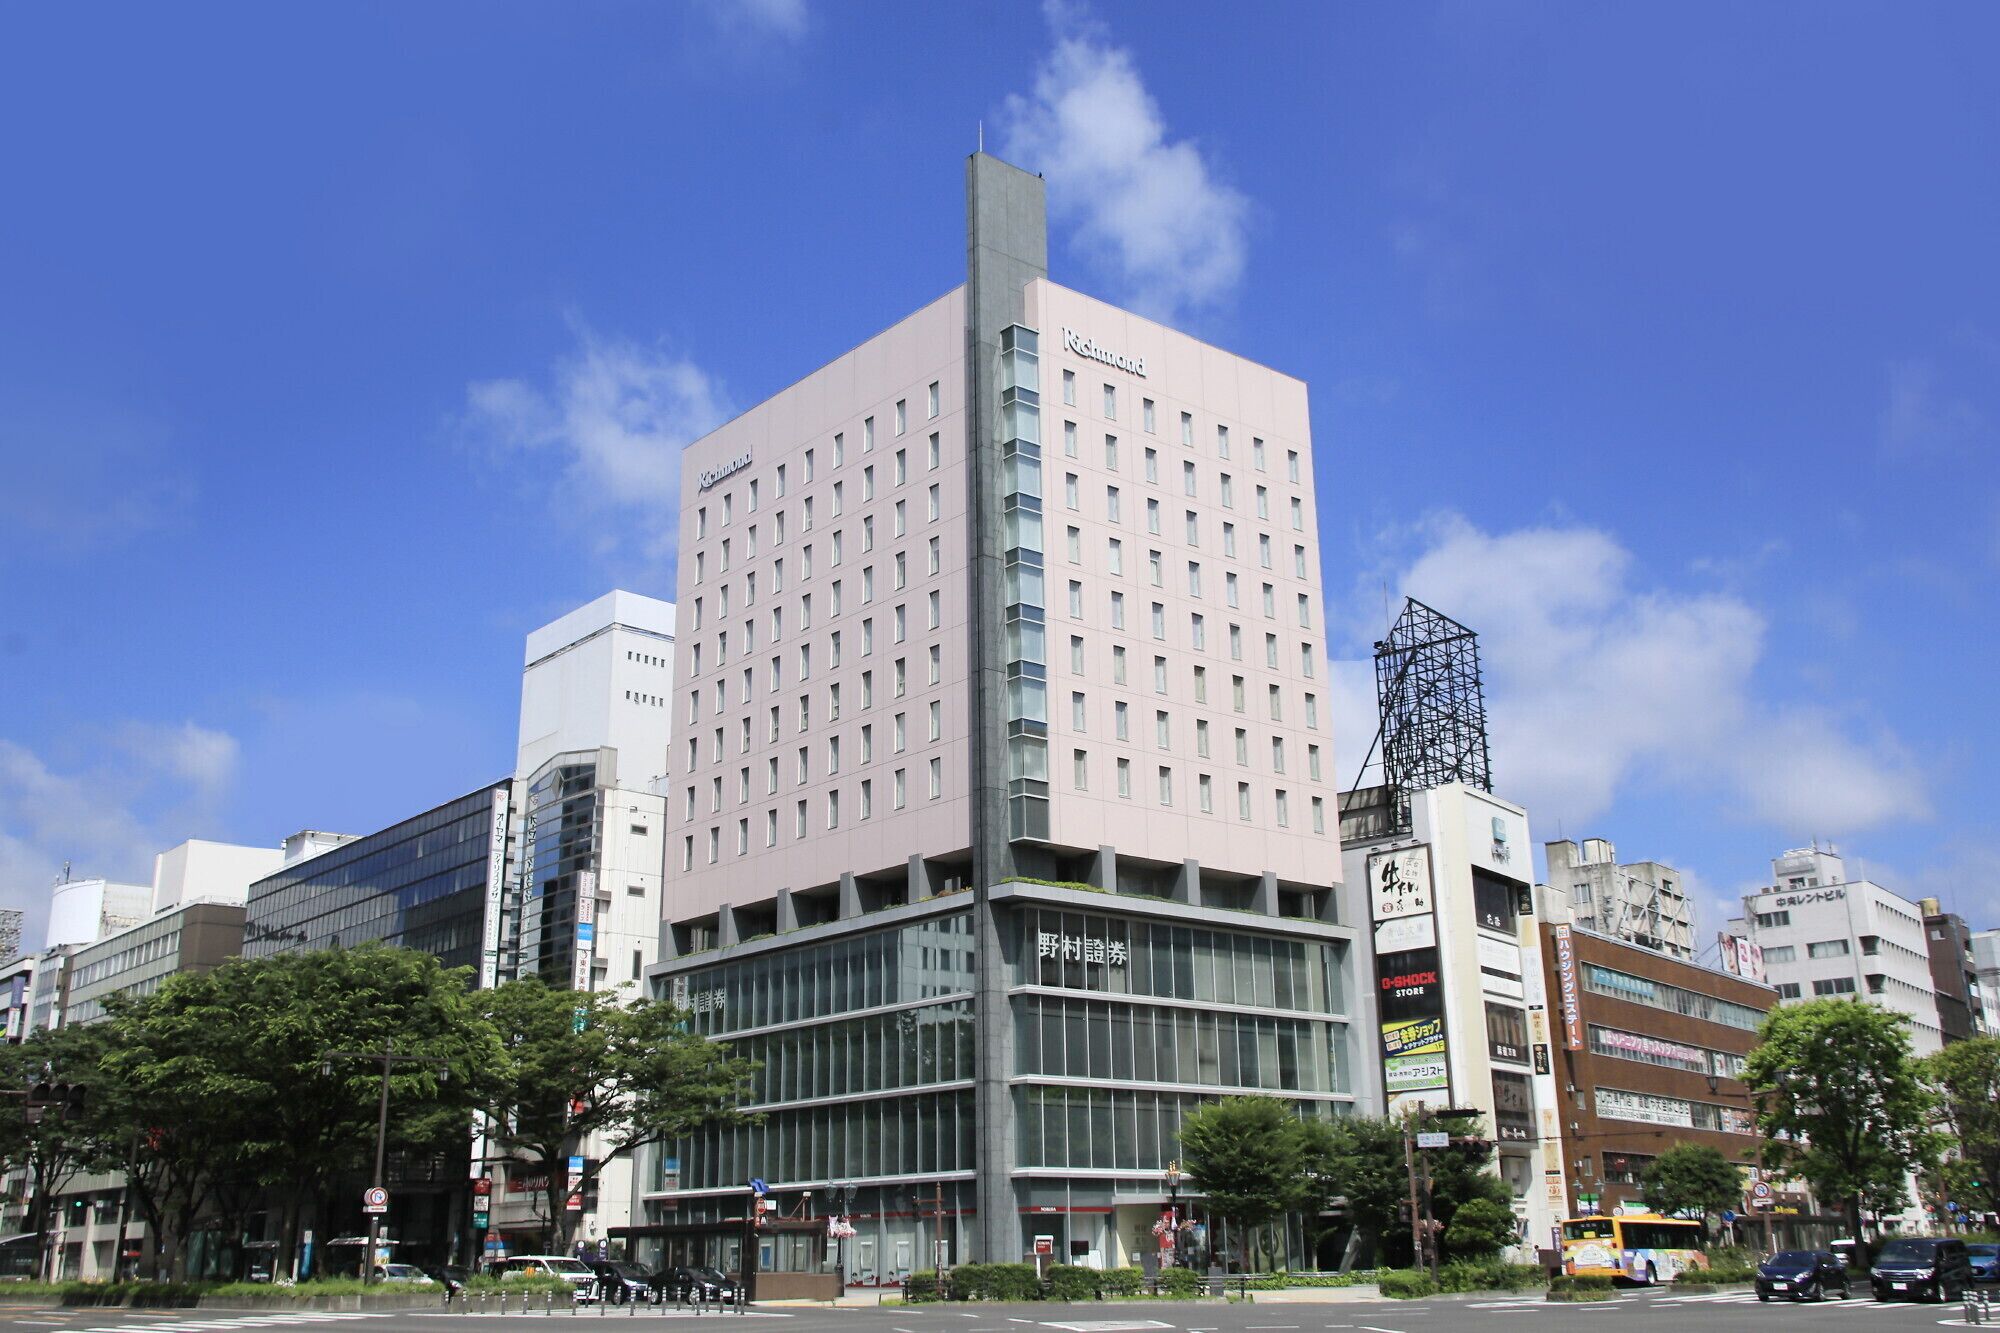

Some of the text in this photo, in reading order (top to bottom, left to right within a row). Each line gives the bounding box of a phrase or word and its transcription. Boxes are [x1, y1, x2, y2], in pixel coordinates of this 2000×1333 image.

[1062, 326, 1147, 377] Richmond
[699, 446, 753, 491] Richmond
[1776, 890, 1846, 907] 中央レントビル
[1039, 931, 1128, 966] 野村證券
[1382, 971, 1437, 989] G-SHOCK
[1396, 986, 1424, 997] STORE
[1560, 940, 1581, 1046] ハウジングエステート
